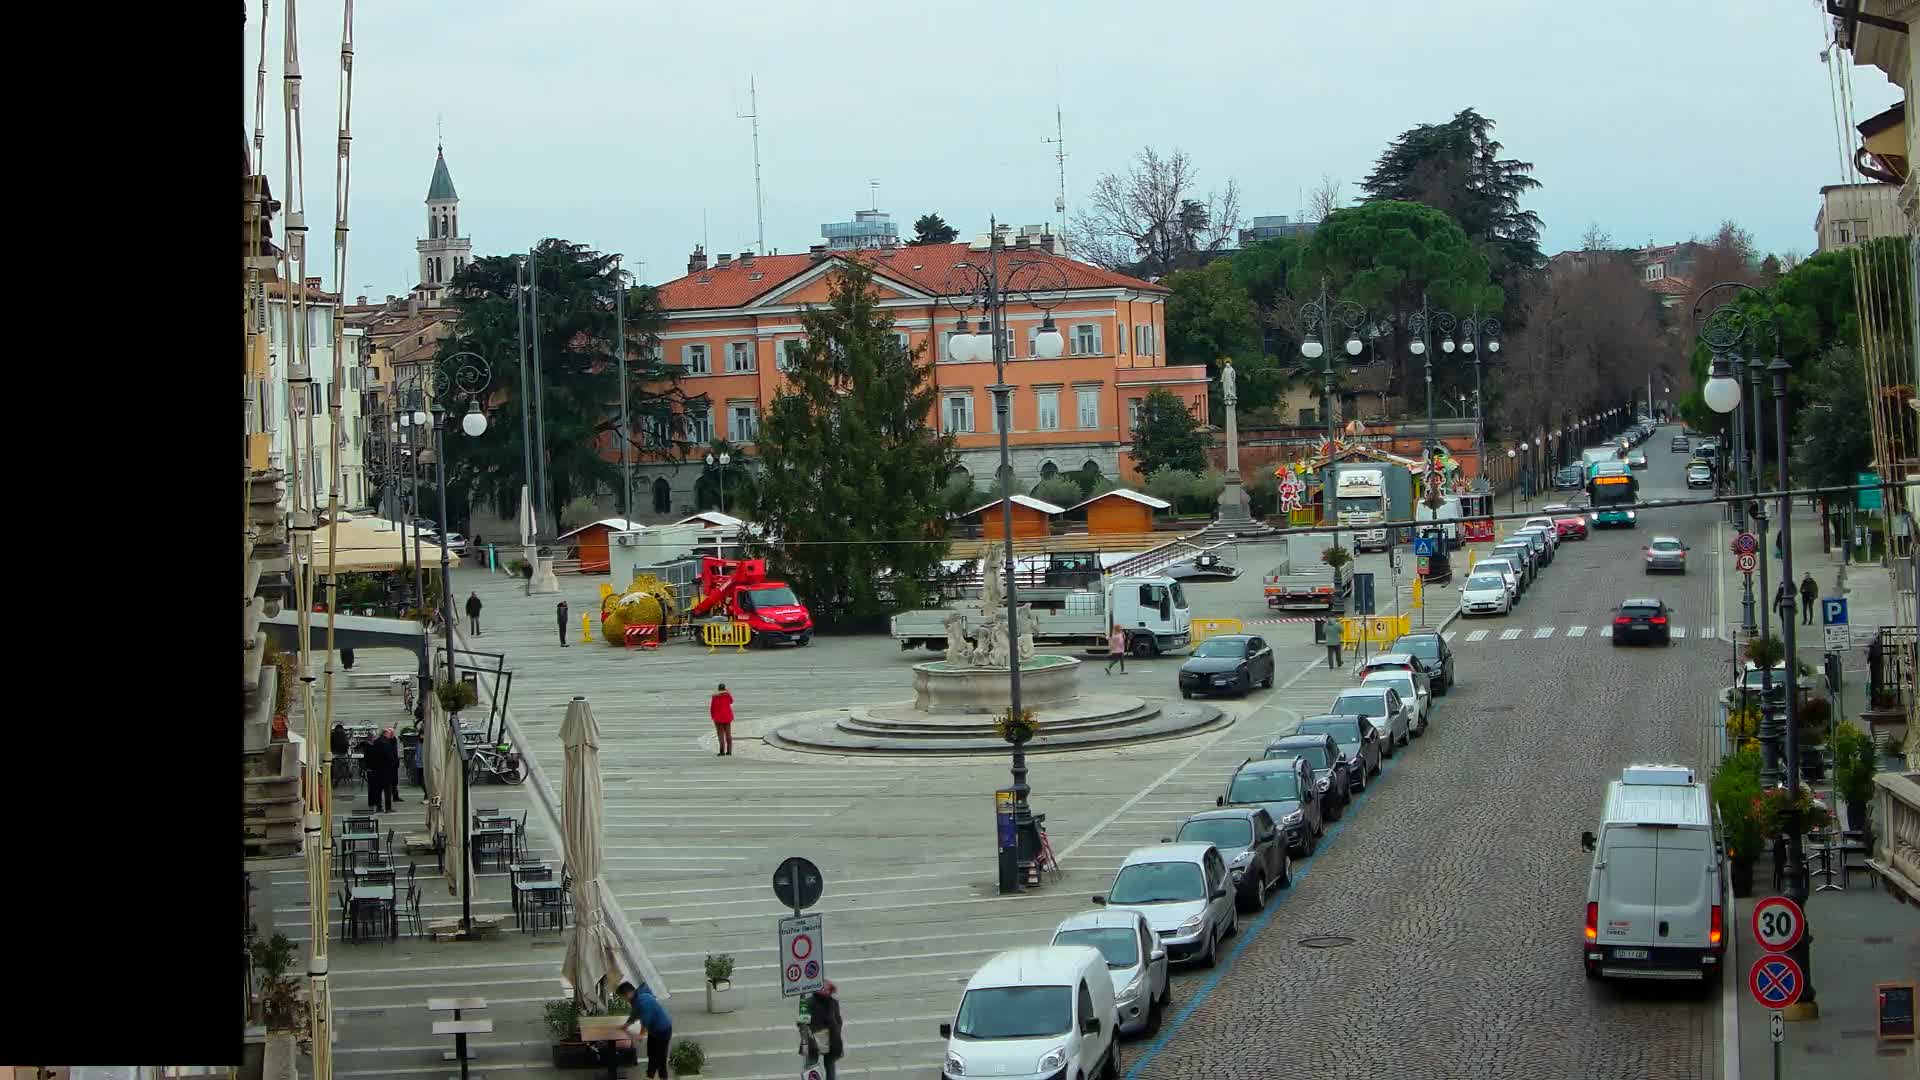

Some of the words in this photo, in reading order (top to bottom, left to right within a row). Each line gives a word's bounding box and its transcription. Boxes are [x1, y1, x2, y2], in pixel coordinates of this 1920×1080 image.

[1742, 558, 1752, 566] 20
[1827, 602, 1842, 621] P
[1762, 911, 1792, 938] 30
